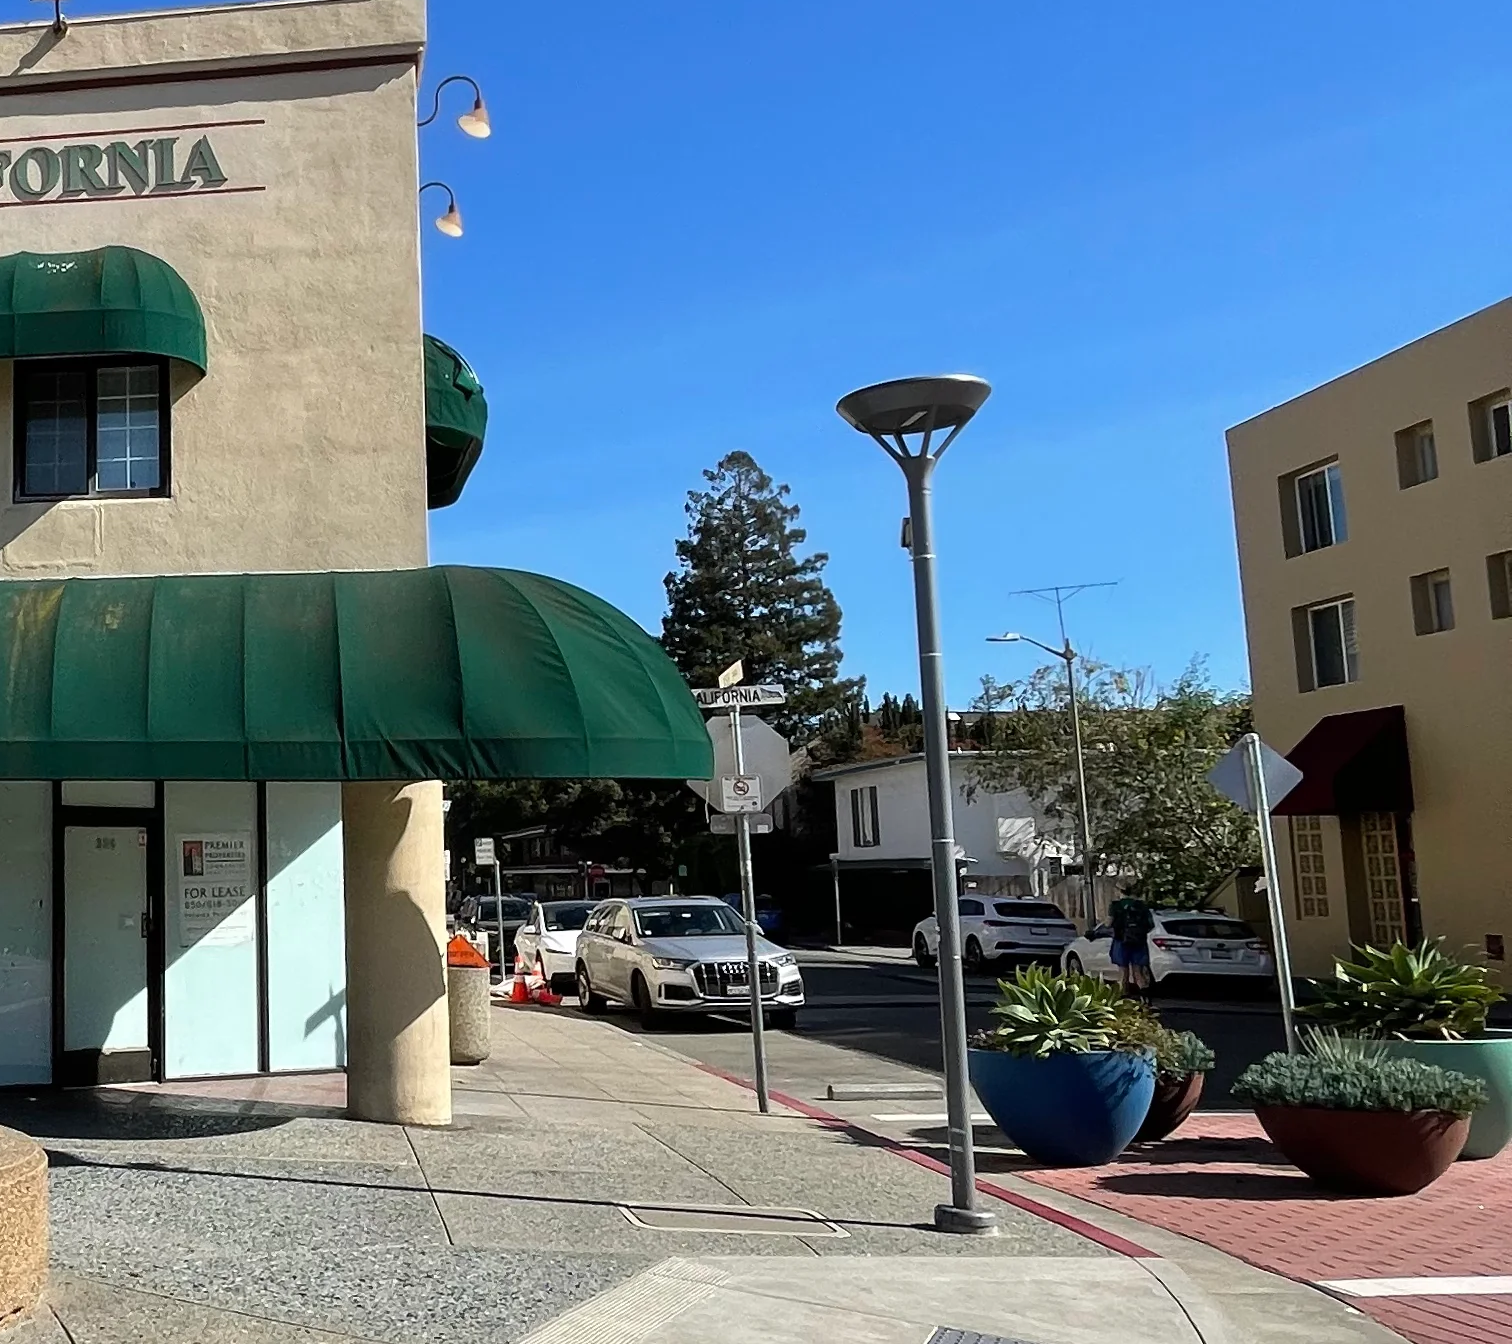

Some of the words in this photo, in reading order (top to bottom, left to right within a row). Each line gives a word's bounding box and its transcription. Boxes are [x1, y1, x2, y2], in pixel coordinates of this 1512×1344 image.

[696, 689, 762, 705] ALIFORNIA
[184, 887, 208, 899] FOR
[212, 886, 246, 898] LEASE
